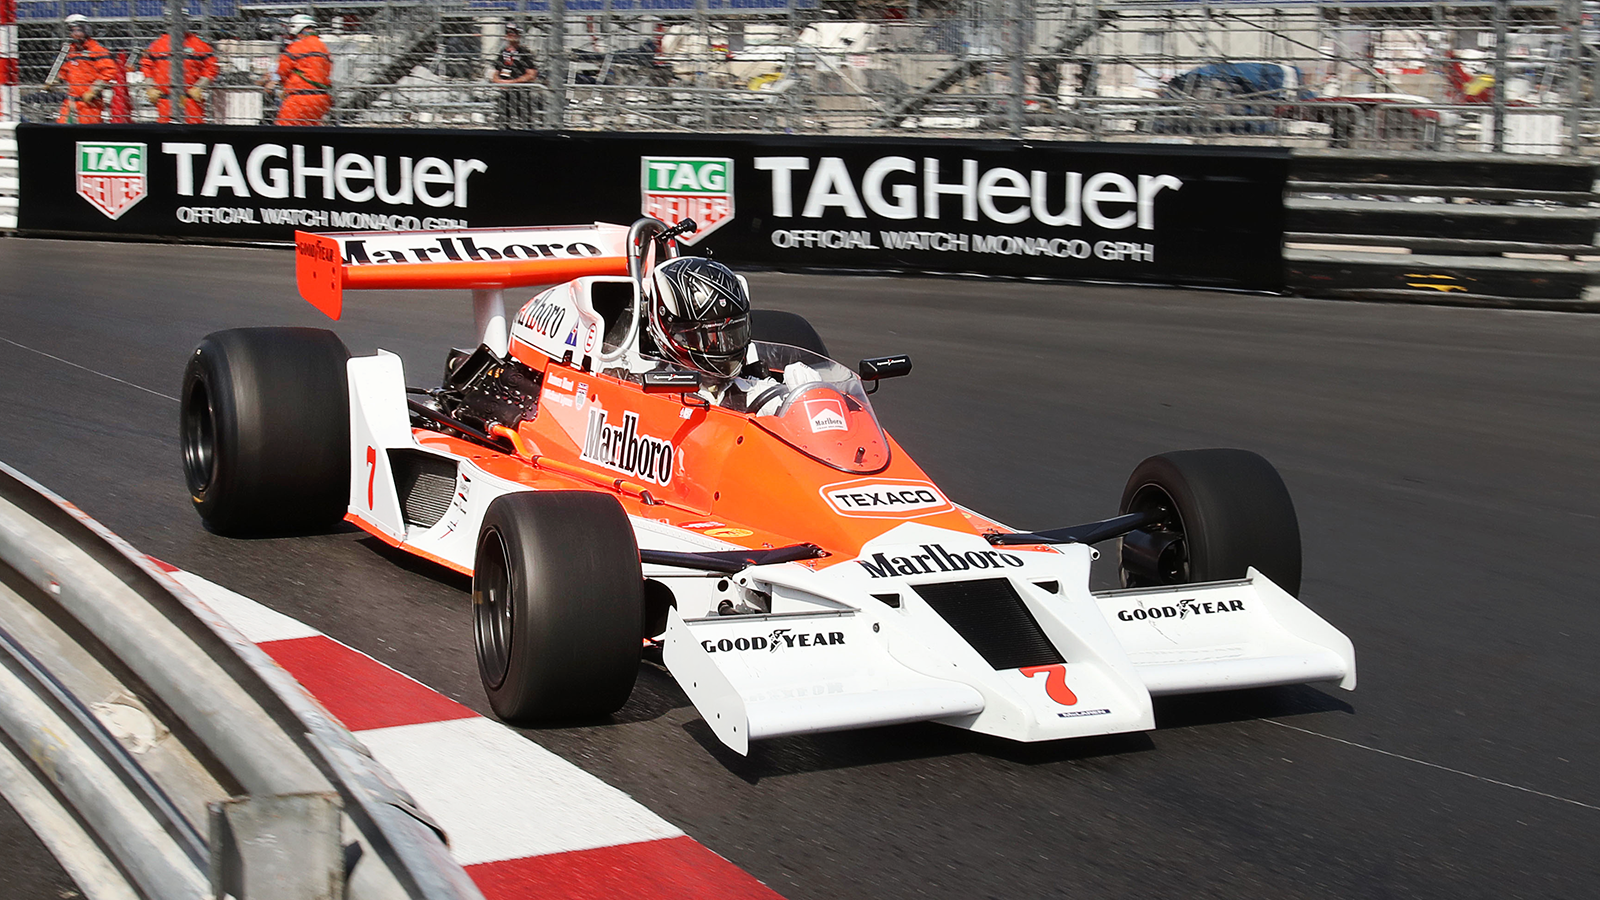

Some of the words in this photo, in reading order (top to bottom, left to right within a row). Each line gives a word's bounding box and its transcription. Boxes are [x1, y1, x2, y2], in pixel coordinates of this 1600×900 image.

[83, 146, 142, 172] TAG
[650, 162, 726, 191] TAG
[82, 176, 143, 213] HEUER
[176, 206, 260, 225] OFFICIAL
[261, 208, 328, 228] WATCH
[331, 211, 421, 231] MONACO
[648, 196, 730, 238] HEUER
[341, 236, 603, 266] Marlboro
[771, 229, 878, 251] OFFICIAL
[881, 231, 968, 252] WATCH
[973, 234, 1092, 259] MONACO
[1094, 239, 1155, 262] GPH
[815, 417, 843, 427] Marlboro
[583, 411, 672, 483] Marlboro
[366, 445, 376, 511] 7
[835, 489, 937, 507] TEXACO
[858, 543, 1025, 579] Marlboro
[1118, 605, 1176, 622] GOOD
[1192, 599, 1245, 615] YEAR
[701, 635, 768, 654] GOOD
[783, 631, 846, 647] YEAR
[1018, 664, 1078, 706] 7
